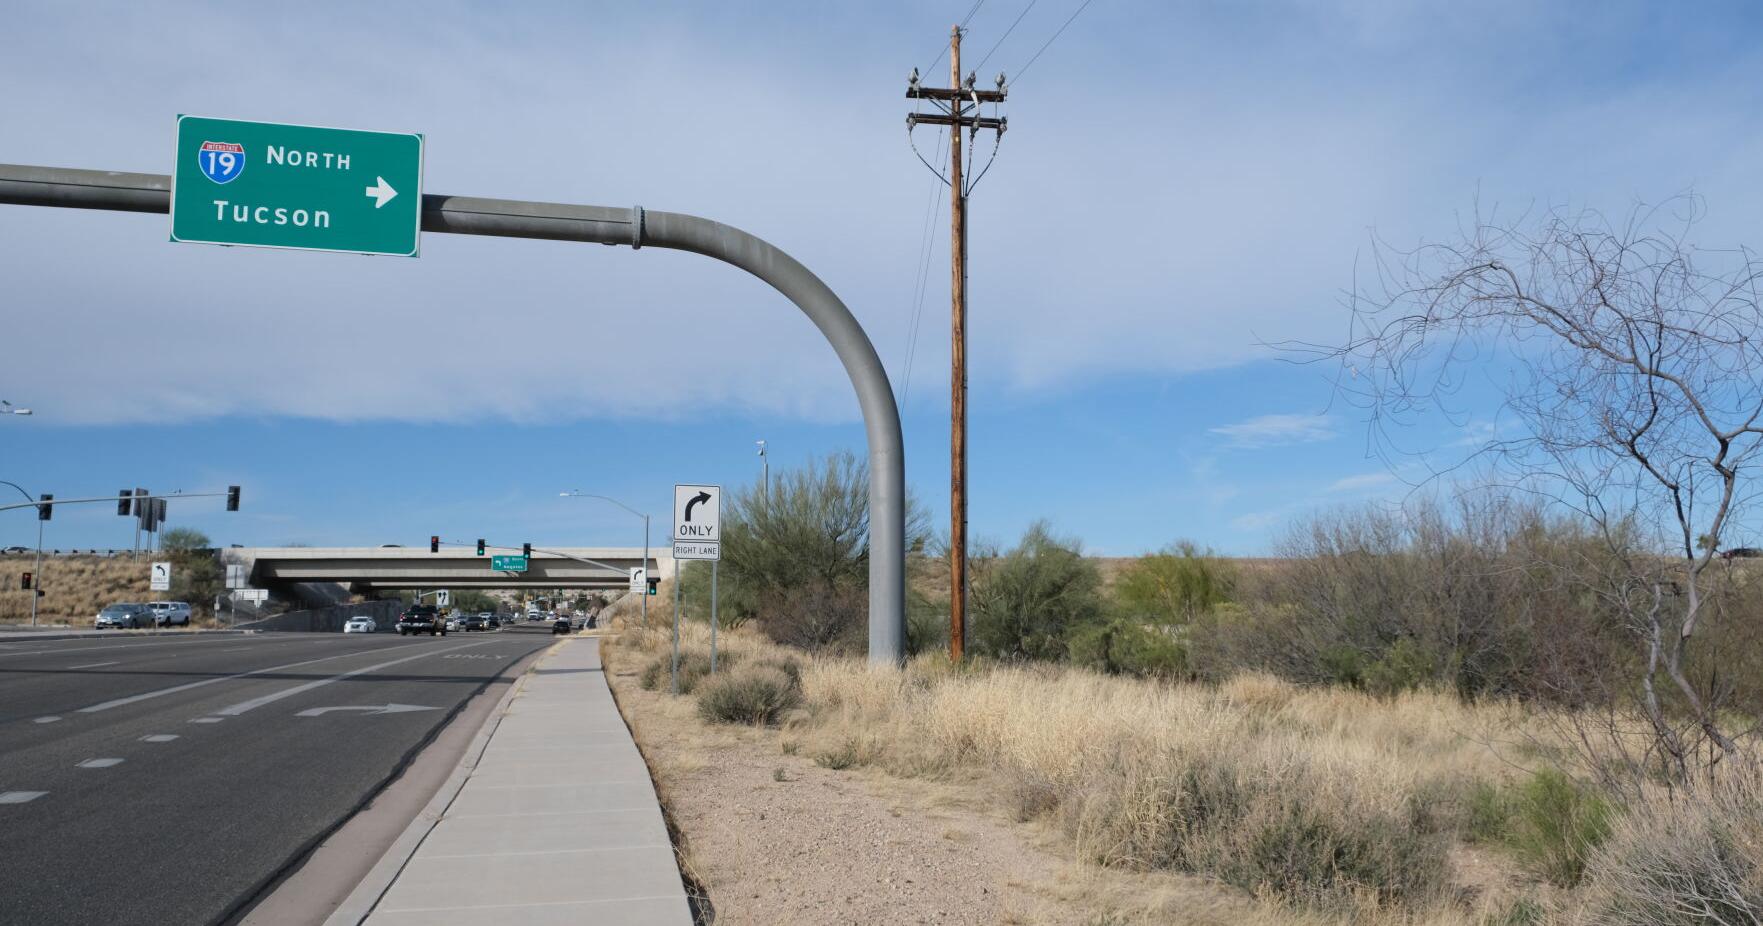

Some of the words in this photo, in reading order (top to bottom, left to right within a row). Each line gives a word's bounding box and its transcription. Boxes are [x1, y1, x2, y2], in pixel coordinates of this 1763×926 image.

[206, 144, 238, 152] INTERSTATE
[208, 152, 236, 176] 19
[213, 199, 330, 228] Tucson
[680, 525, 713, 536] ONLY
[675, 546, 697, 555] RIGHT
[699, 547, 717, 555] LANE
